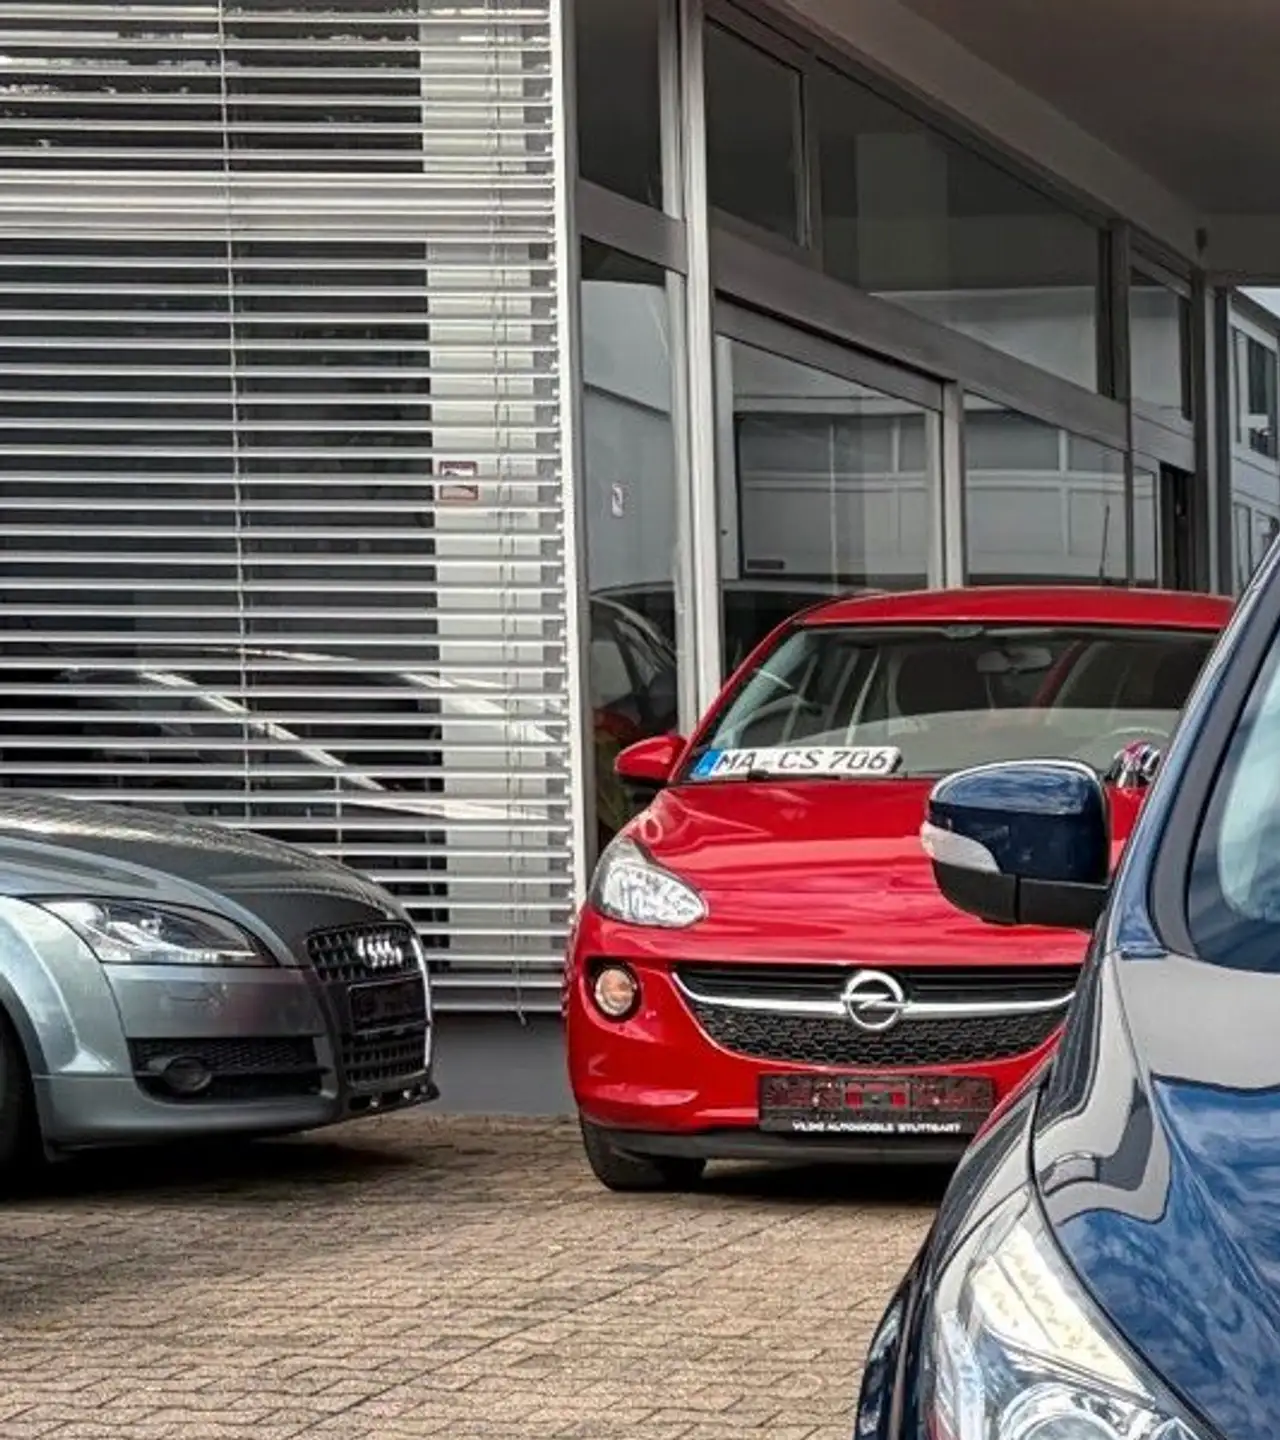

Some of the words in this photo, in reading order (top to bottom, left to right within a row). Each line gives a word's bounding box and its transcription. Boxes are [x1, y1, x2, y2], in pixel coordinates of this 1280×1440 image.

[715, 751, 757, 772] MA
[778, 750, 823, 769] CS
[828, 750, 888, 770] 706
[898, 1122, 961, 1133] STUTTGART
